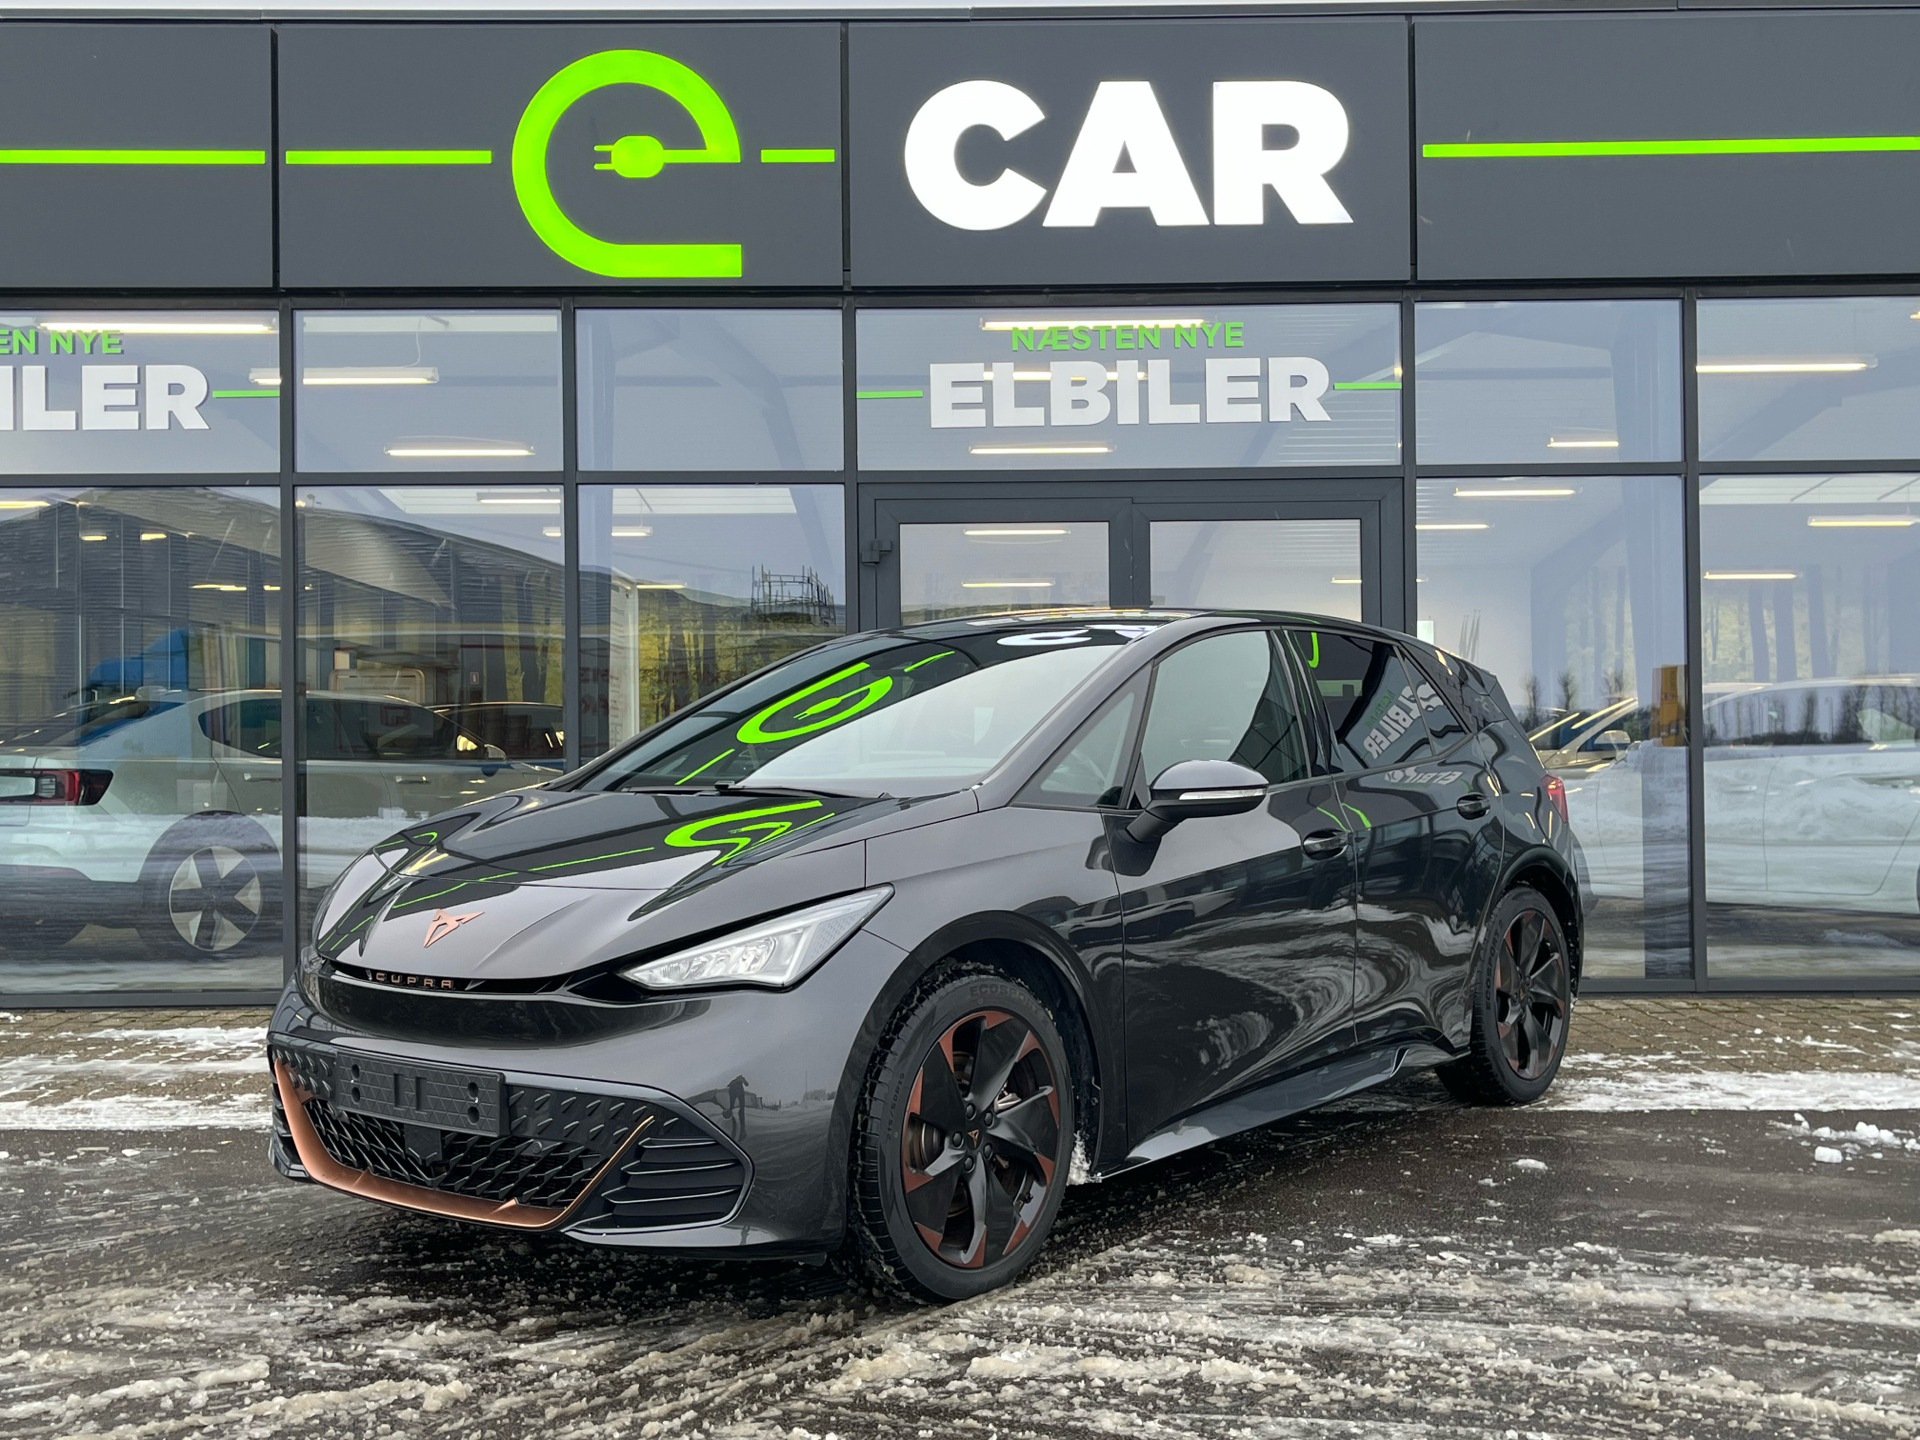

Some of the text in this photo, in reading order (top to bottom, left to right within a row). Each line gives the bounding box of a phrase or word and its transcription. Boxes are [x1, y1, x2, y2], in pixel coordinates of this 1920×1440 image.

[904, 79, 1353, 231] CAR
[50, 329, 122, 354] NYE
[1011, 321, 1245, 351] NÆSTEN NYE
[929, 356, 1331, 428] ELBILER
[375, 972, 452, 989] CUPRA
[1485, 930, 1500, 1010] ECOSPORT
